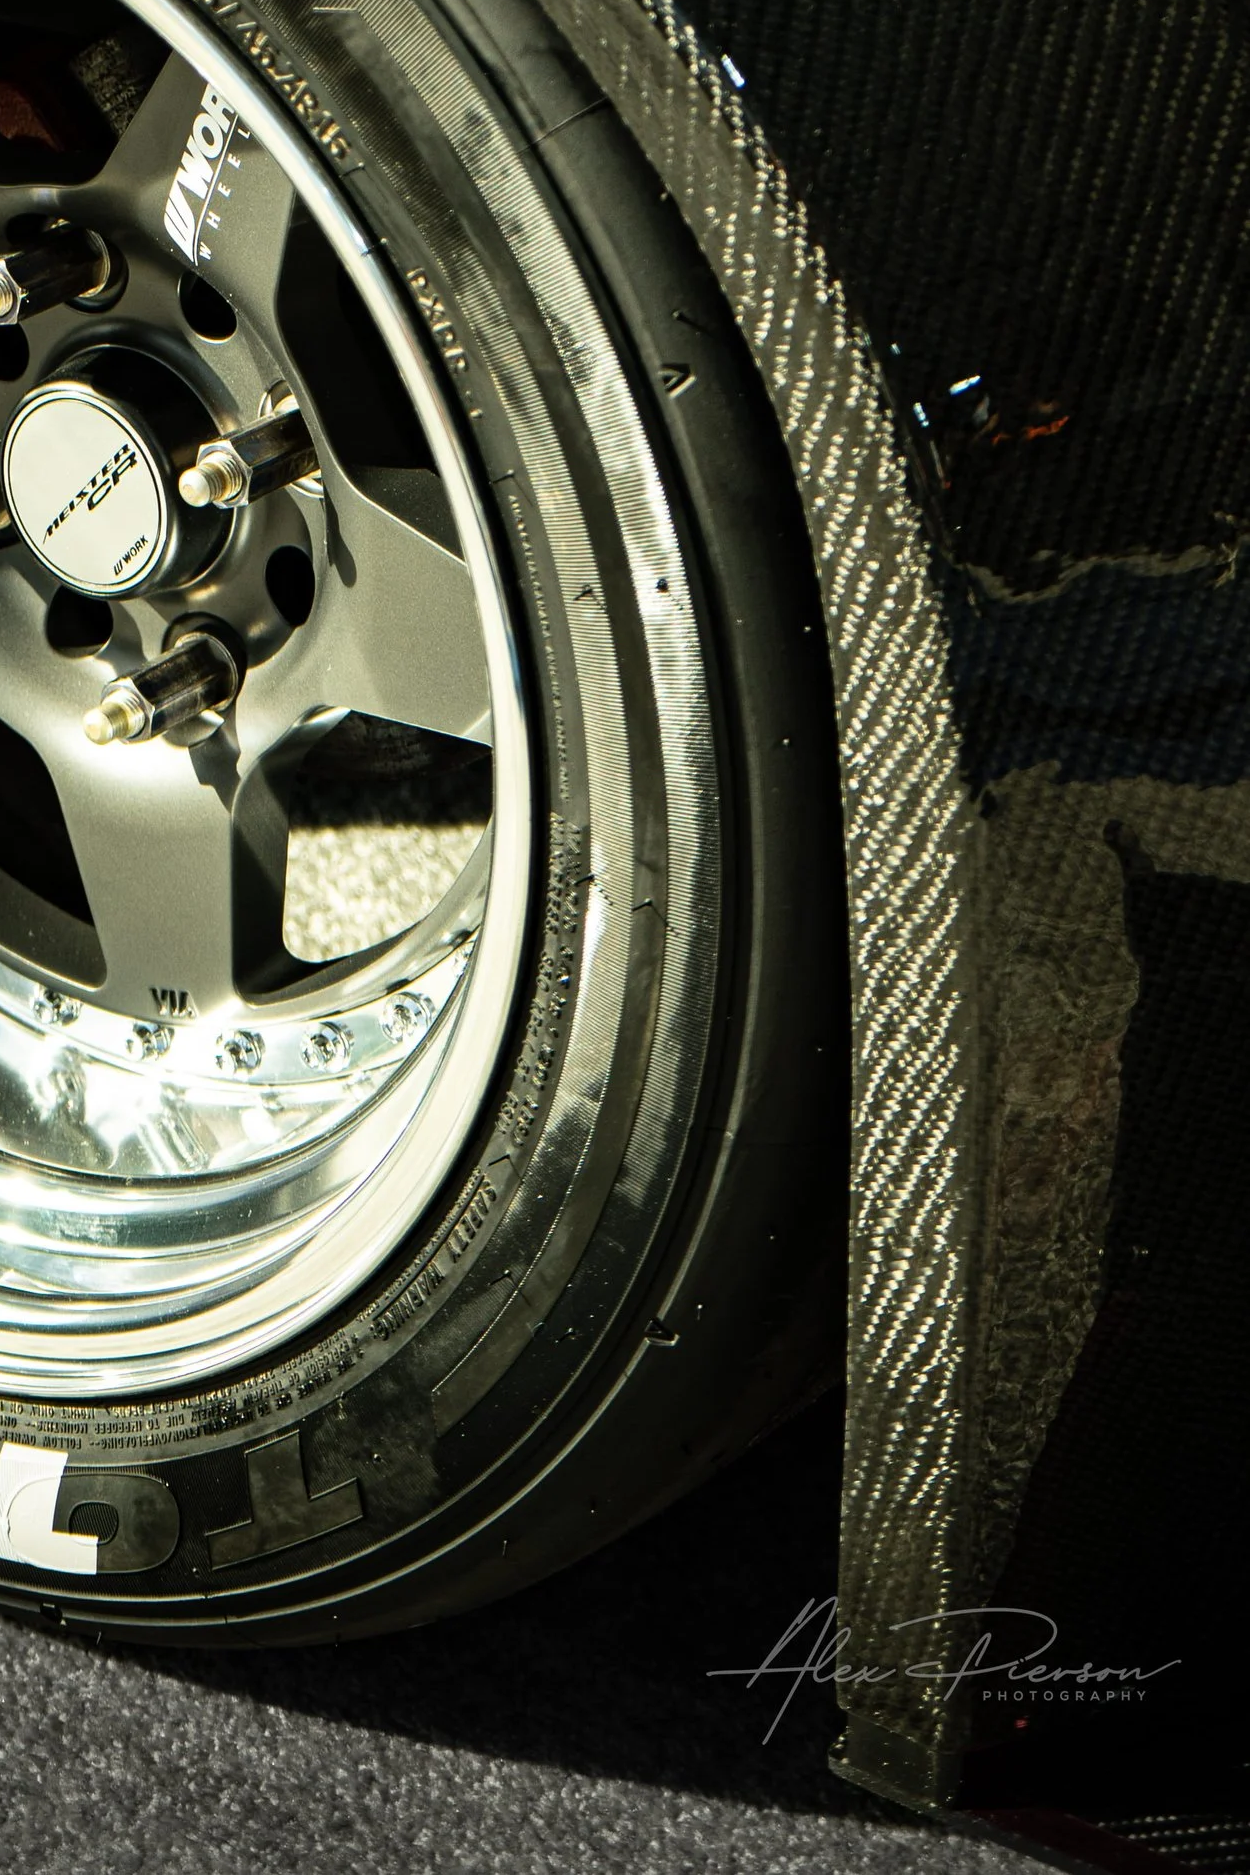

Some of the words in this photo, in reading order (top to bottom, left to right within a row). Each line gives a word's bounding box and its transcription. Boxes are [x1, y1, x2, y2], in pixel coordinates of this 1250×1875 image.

[177, 83, 237, 200] WOR
[199, 126, 251, 261] WHEEL
[43, 443, 131, 545] MEISTER
[87, 451, 138, 511] CR
[122, 535, 149, 565] WORK
[445, 1178, 497, 1264] SAFETY
